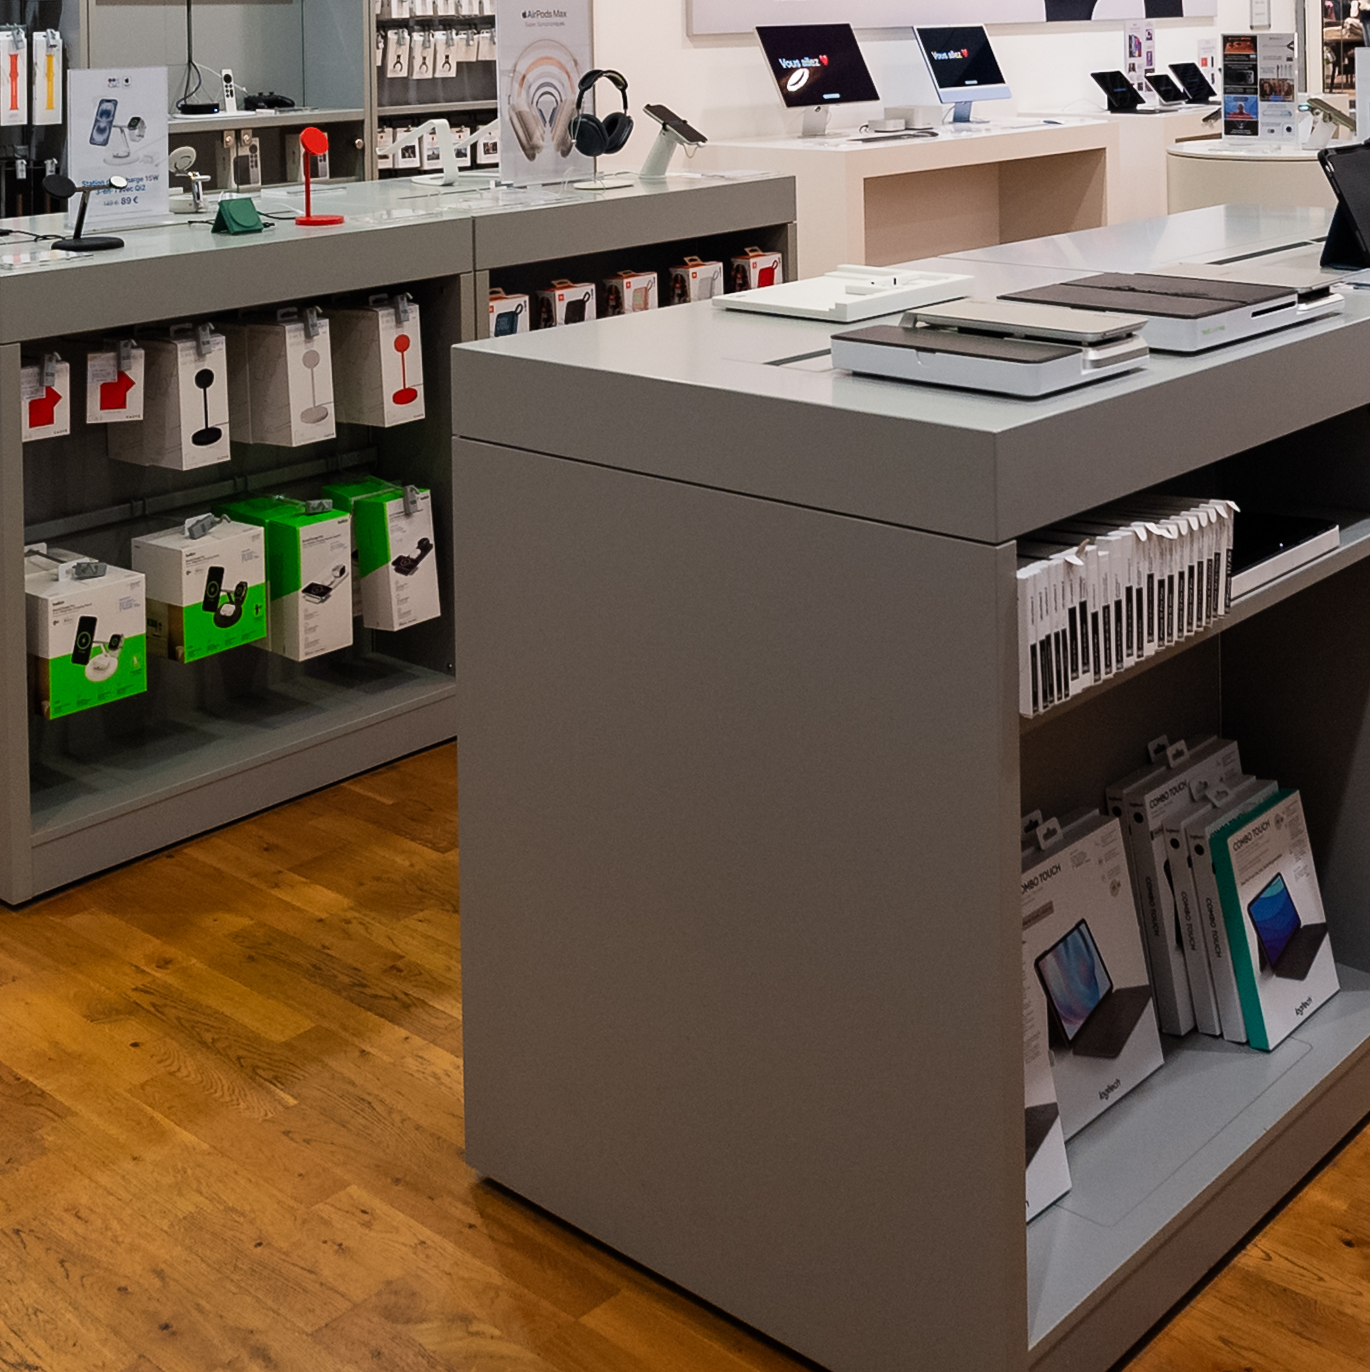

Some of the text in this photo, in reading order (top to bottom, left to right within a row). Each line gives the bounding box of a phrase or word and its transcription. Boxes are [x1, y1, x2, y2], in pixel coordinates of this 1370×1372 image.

[528, 9, 567, 19] AirPods Max
[778, 58, 801, 69] Vous
[121, 197, 132, 205] 89
[133, 196, 138, 204] €
[1149, 779, 1188, 809] COMBO TOUCH
[1232, 831, 1253, 852] COMBO
[1252, 819, 1272, 838] TOUCH
[1040, 863, 1062, 886] TOUCH
[1145, 876, 1160, 937] COMBO TOUCH
[1181, 891, 1197, 951] COMBO TOUCH
[1205, 897, 1222, 958] COMBO TOUCH
